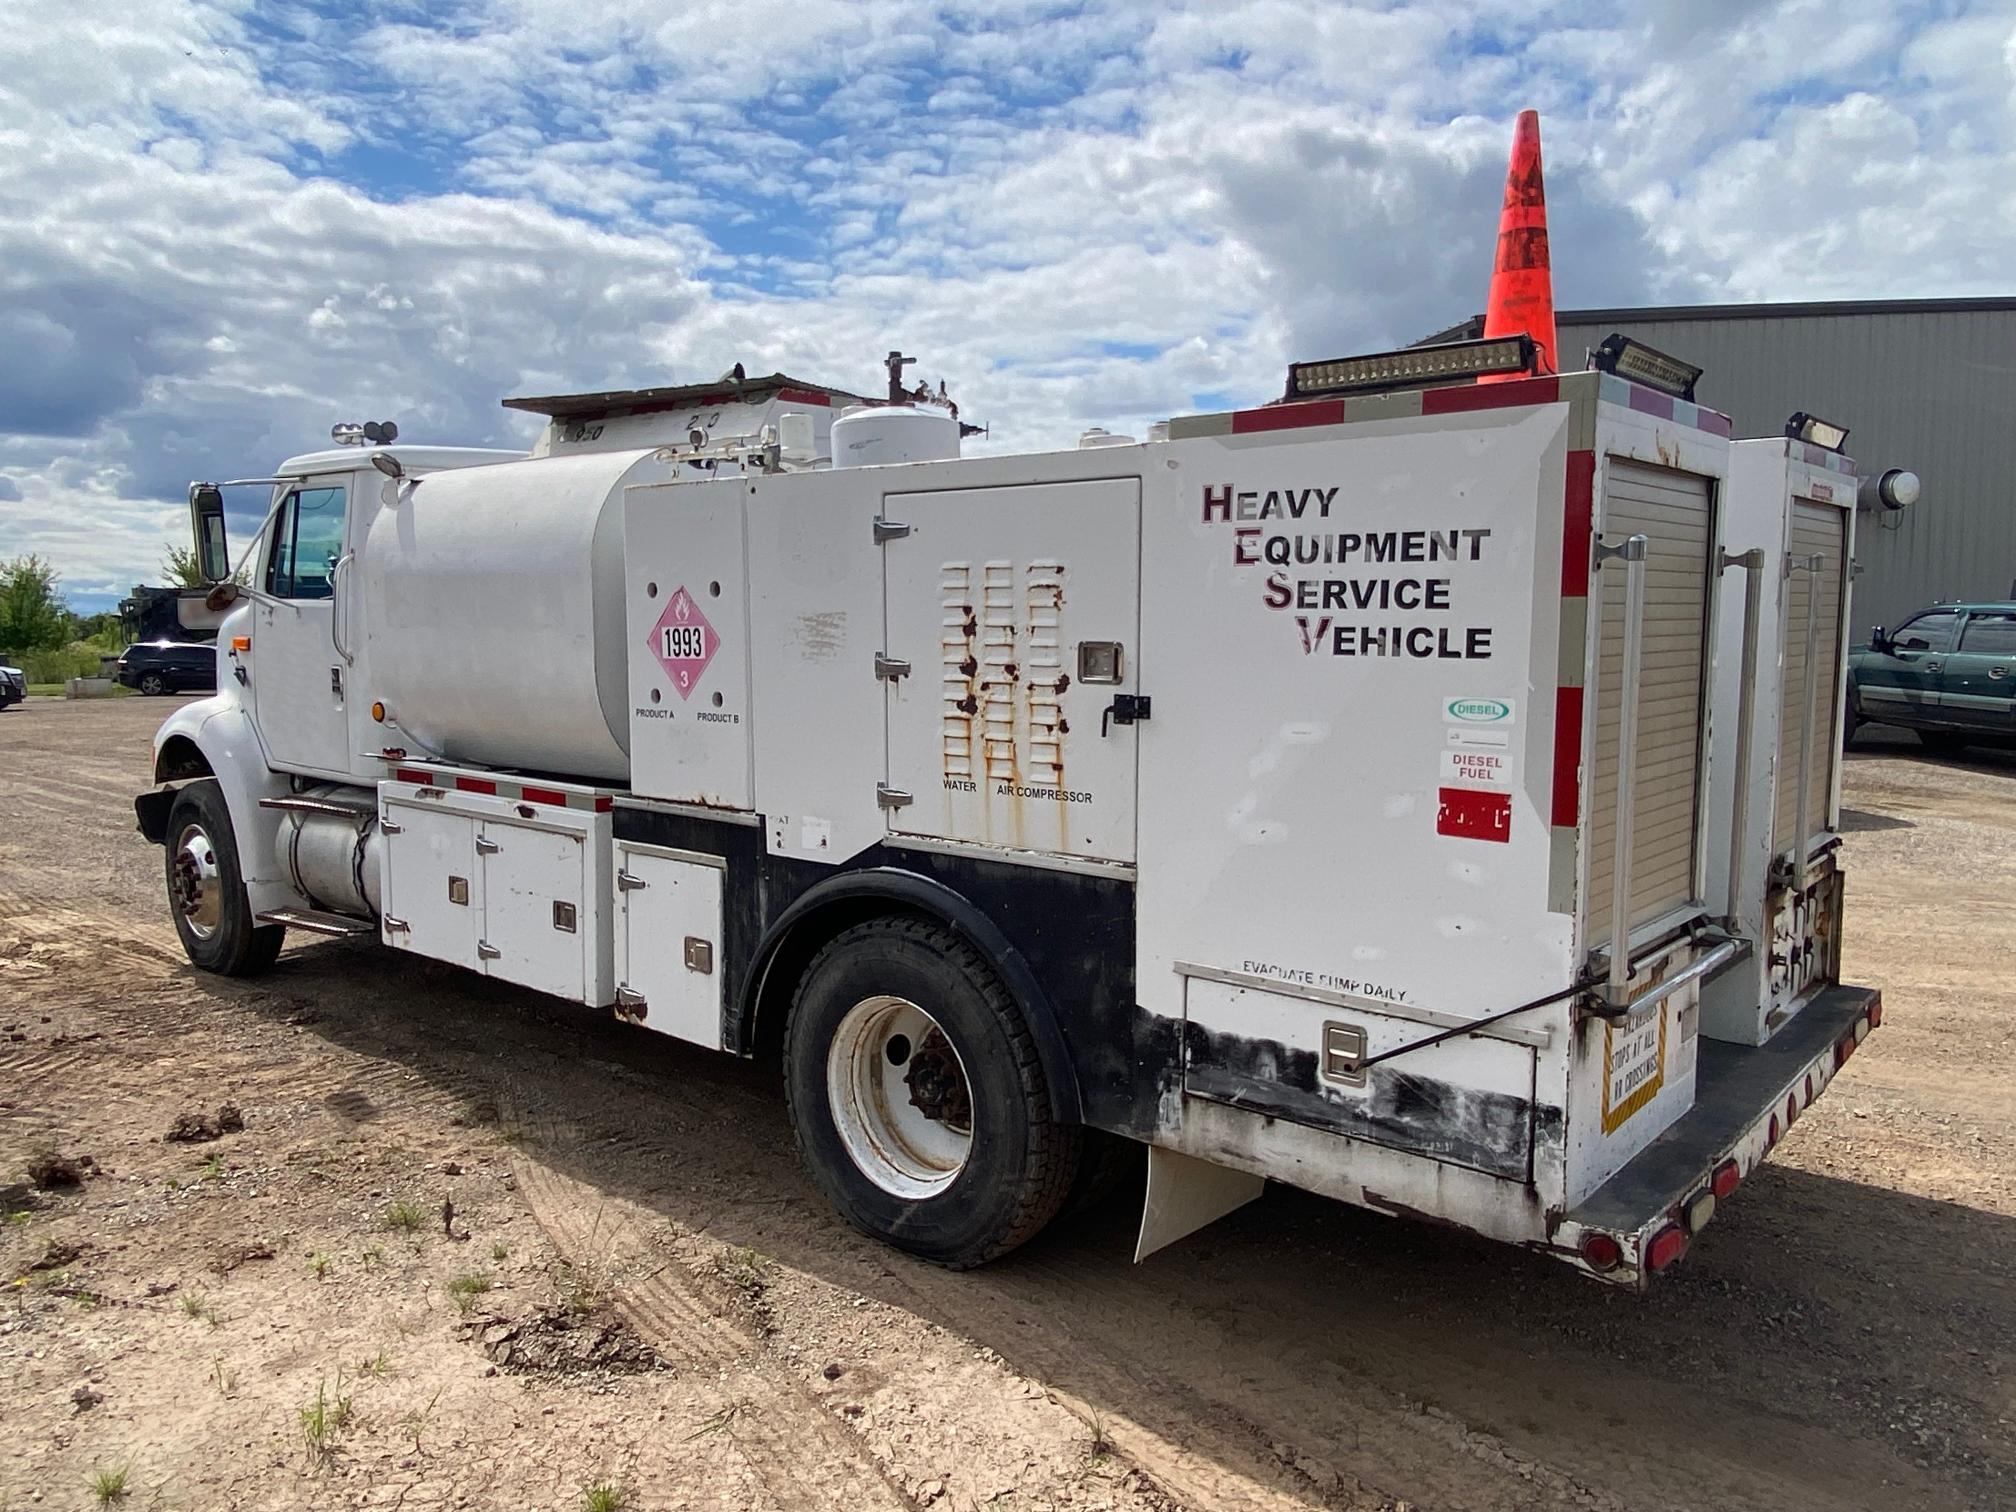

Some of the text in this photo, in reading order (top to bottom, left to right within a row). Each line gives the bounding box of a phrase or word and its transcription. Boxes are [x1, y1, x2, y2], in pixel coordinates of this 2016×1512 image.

[1202, 483, 1340, 523] HEAVY
[1233, 526, 1491, 567] EQUIPMENT
[1263, 570, 1451, 612] SERVICE
[665, 627, 702, 657] 1993
[1295, 616, 1493, 659] VEHICLE
[680, 670, 689, 688] 3
[636, 708, 675, 720] PRODUCT A
[697, 712, 740, 724] PRODUCT B
[1457, 703, 1499, 716] DIESEL
[1452, 754, 1503, 768] DIESEL
[1459, 767, 1494, 780] FUEL
[943, 779, 977, 792] WATER
[997, 784, 1093, 804] AIR COMPRESSOR
[1364, 982, 1407, 1001] DAILY
[1610, 1029, 1655, 1074] STOPS AT ALL
[1614, 1051, 1658, 1101] RR CROSSINGS
